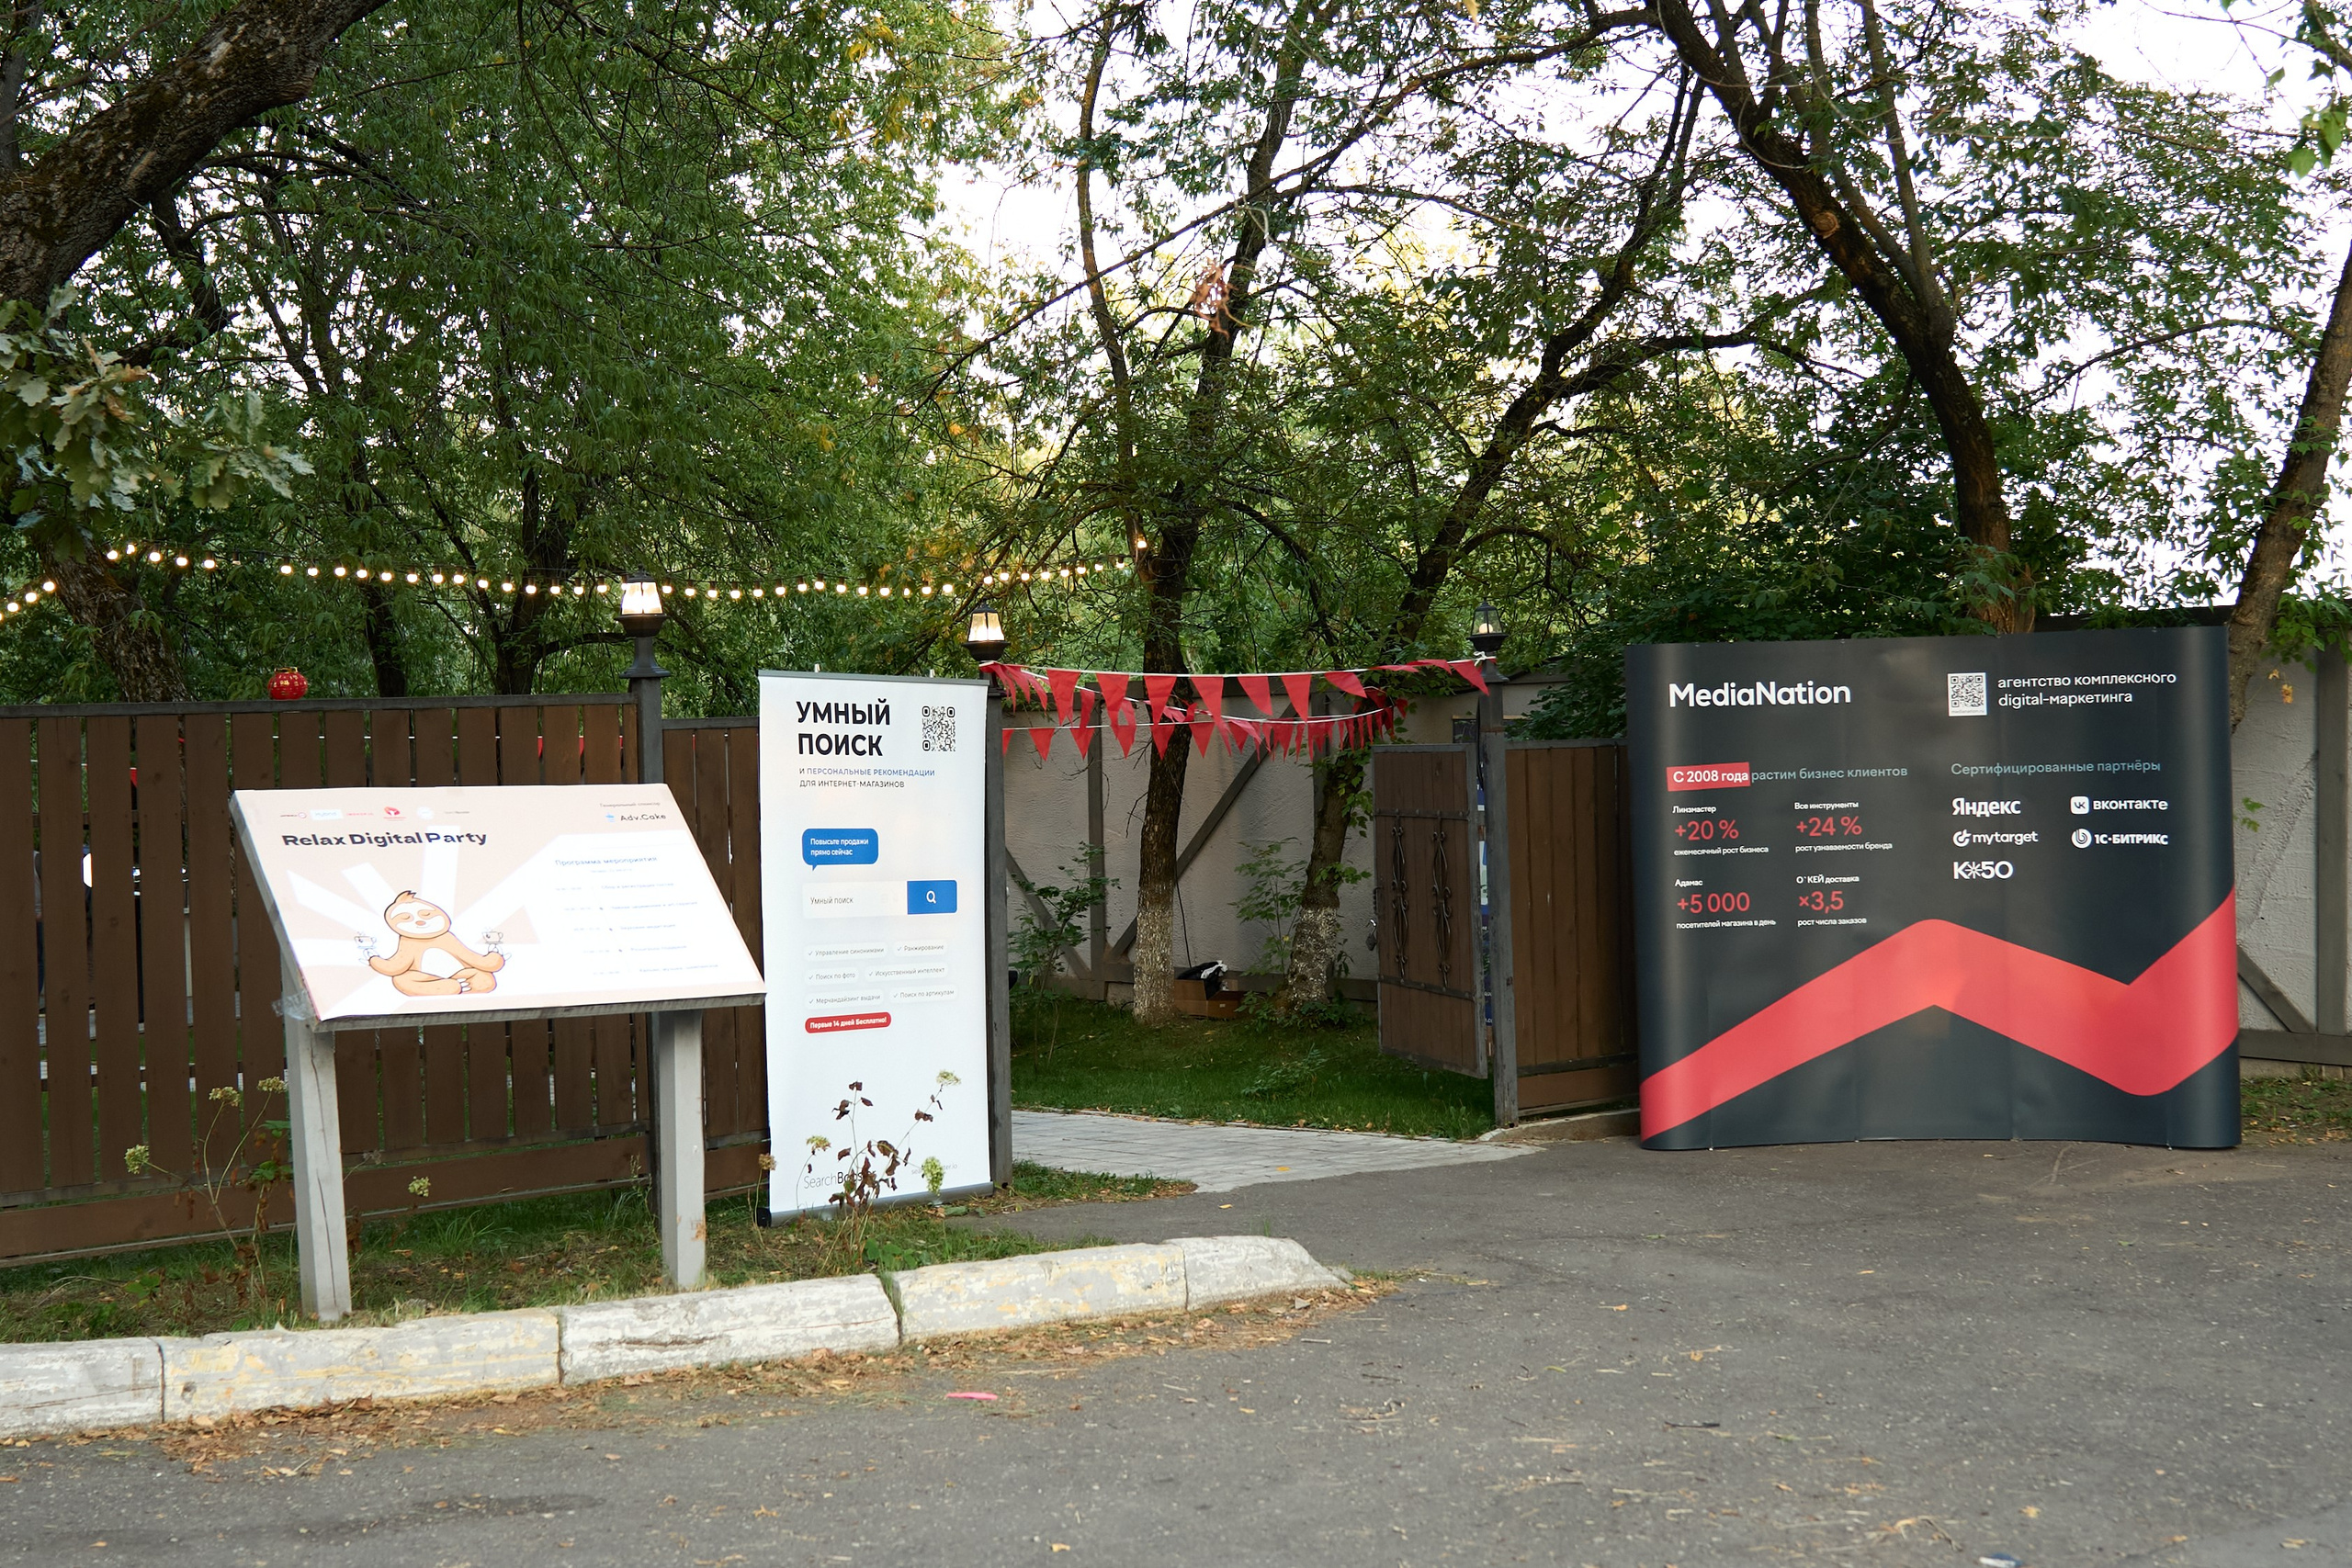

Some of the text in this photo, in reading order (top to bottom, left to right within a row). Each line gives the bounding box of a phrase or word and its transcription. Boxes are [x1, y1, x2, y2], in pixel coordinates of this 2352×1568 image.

[1997, 672, 2177, 688] агентство комплексного
[1668, 681, 1851, 707] MediaNation
[1998, 692, 2132, 710] digital-маркетинга
[796, 698, 890, 725] УМНЫЙ
[798, 733, 883, 756] ПОИСК
[807, 768, 872, 776] ПЕРСОНАЛЬНЫЕ
[873, 769, 935, 777] РЕКОМЕНДАЦИИ
[1951, 759, 2161, 777] Сертифицированные партнёры
[1673, 766, 1907, 784] С 2008 года растим бизнес клиентов
[799, 780, 816, 788] ДЛЯ
[1672, 805, 1716, 814] Линзмастер
[1794, 800, 1859, 810] Все инструменты
[1952, 797, 2021, 818] Яндекс
[621, 813, 667, 821] Adv.Cake
[1675, 819, 1739, 841] +20 %
[1796, 816, 1862, 837] +24 %
[282, 830, 488, 850] Relax Digital Party
[810, 838, 869, 846] Повысьте продажи
[1973, 829, 2039, 845] mytarget
[831, 848, 854, 856] сейчас
[1674, 844, 1769, 857] ежемесячный рост бизнеса
[1795, 841, 1893, 853] рост узнаваемости бренда
[1675, 878, 1702, 887] Адамас
[1825, 874, 1860, 885] доставка
[810, 896, 832, 905] Умный
[1676, 919, 1721, 930] посетителей
[1798, 916, 1867, 927] рост числа заказов
[815, 949, 849, 957] Управление
[903, 943, 944, 953] Ранжирование
[842, 972, 856, 980] фото
[875, 966, 944, 976] Искусственный интеллект
[926, 988, 955, 998] артикулам
[816, 994, 881, 1005] Мерчандайзинг выдачи
[809, 1015, 887, 1031] Первые 14 дней Бесплатно!
